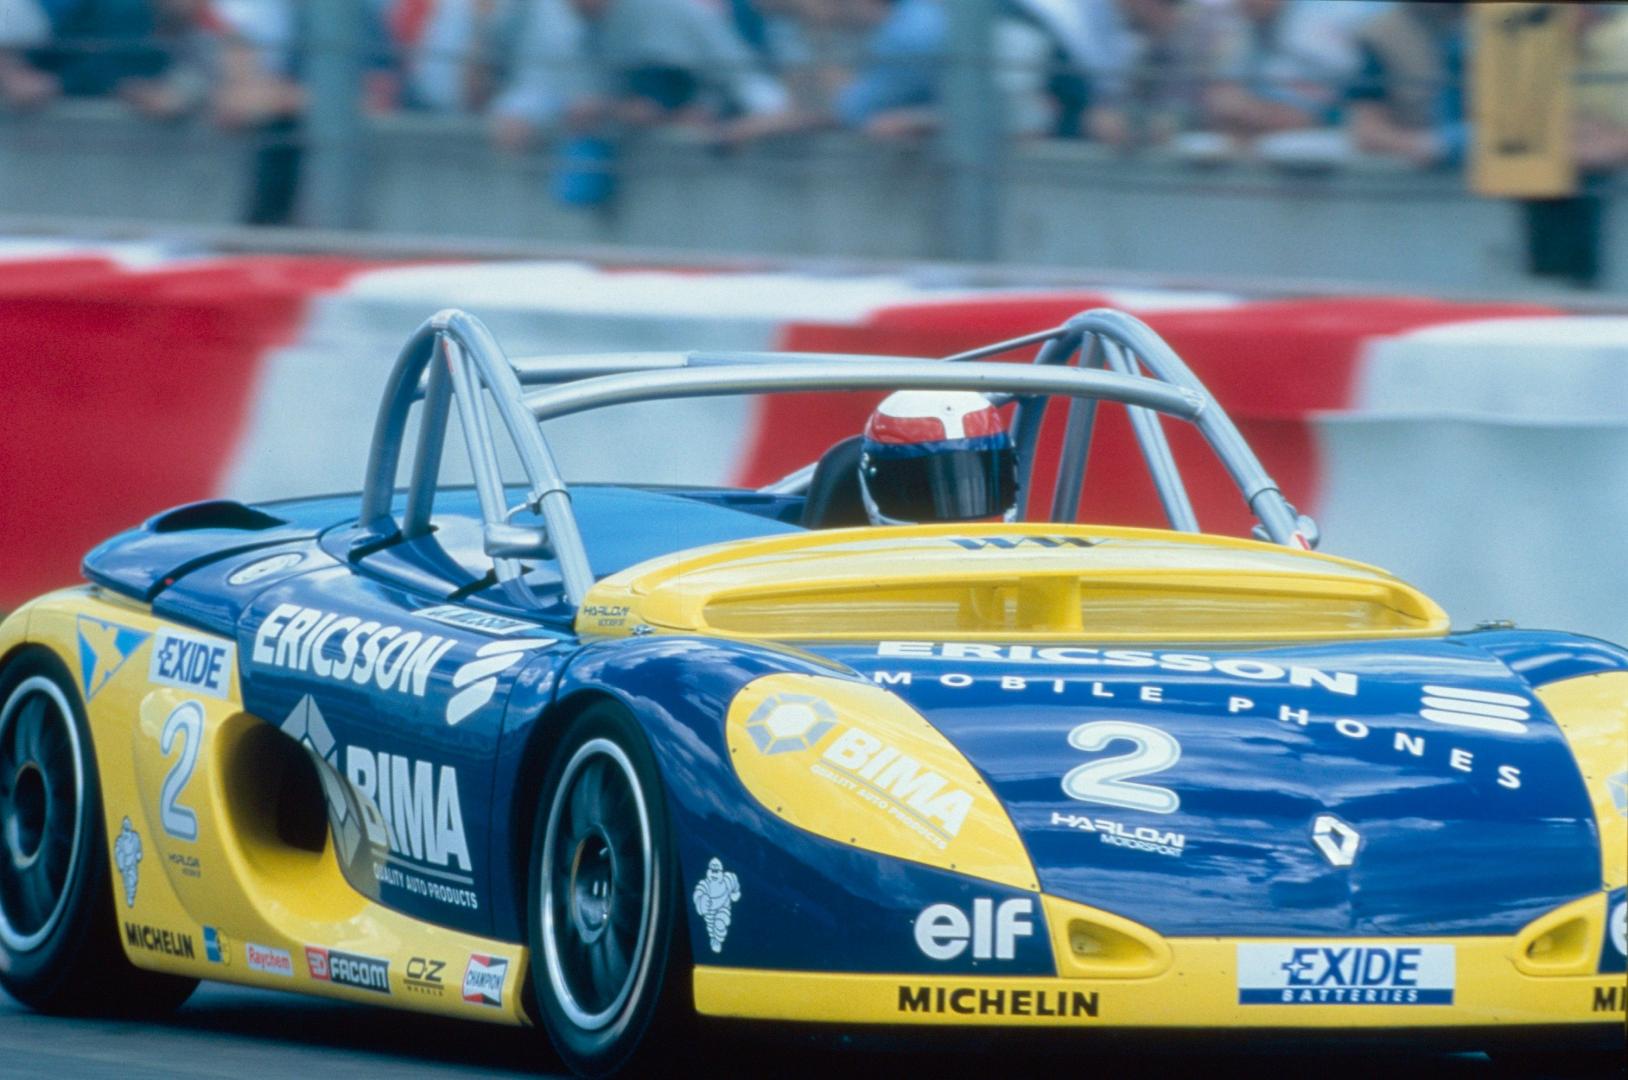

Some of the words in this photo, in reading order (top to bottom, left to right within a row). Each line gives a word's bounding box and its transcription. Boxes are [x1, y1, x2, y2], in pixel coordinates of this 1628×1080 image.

[158, 636, 226, 689] EXIDE
[252, 603, 458, 697] ERICSSON
[877, 640, 1358, 697] ERICSSON
[873, 670, 1163, 703] MOBILE
[1229, 697, 1521, 789] PHONES
[160, 699, 205, 842] 2
[822, 727, 975, 837] BIMA
[1061, 720, 1181, 815] 2
[346, 744, 472, 872] BIMA
[373, 862, 404, 888] QUALITY
[406, 874, 428, 896] AUTO
[427, 882, 479, 910] PRODUCTS
[125, 922, 195, 960] MICHELIN
[914, 898, 1033, 960] elf
[248, 946, 290, 973] Raychem
[330, 957, 388, 989] FACOM
[466, 969, 501, 991] CHAMPION
[1282, 948, 1422, 986] EXIDE
[898, 985, 1099, 1017] MICHELIN
[1281, 989, 1418, 1002] BATTERIES
